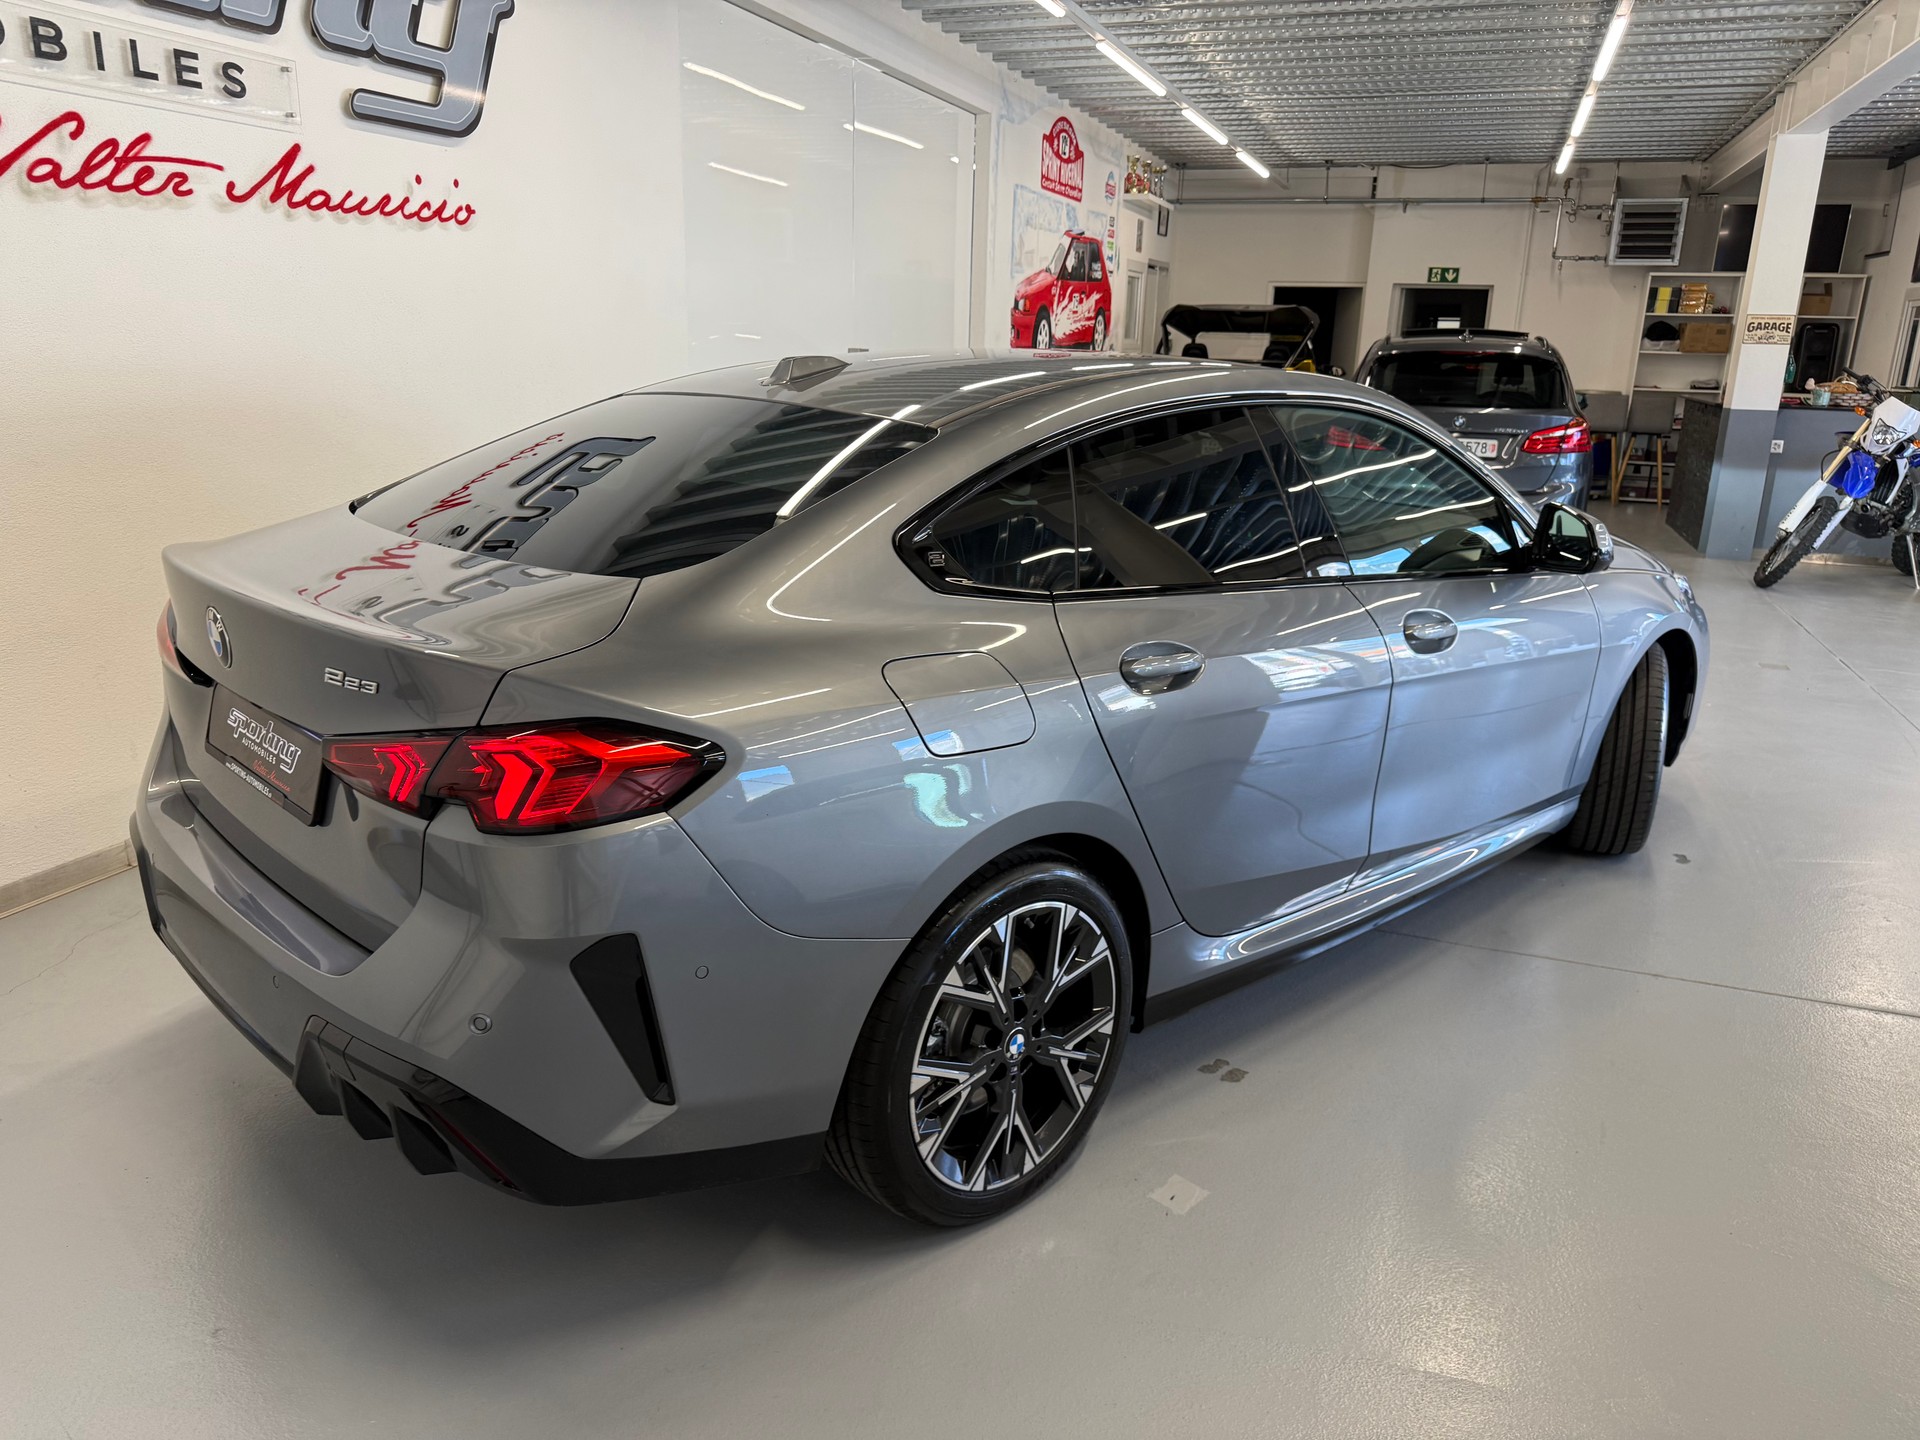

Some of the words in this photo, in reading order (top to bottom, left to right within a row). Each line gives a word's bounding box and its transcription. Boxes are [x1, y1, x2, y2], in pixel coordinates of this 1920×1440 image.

[0, 16, 248, 100] BILES
[225, 143, 476, 227] Mauricio
[1747, 321, 1792, 334] GARAGE
[1460, 441, 1487, 454] 578
[324, 667, 379, 694] 223
[227, 707, 301, 774] sporting
[242, 737, 276, 764] AUTOMOBILES
